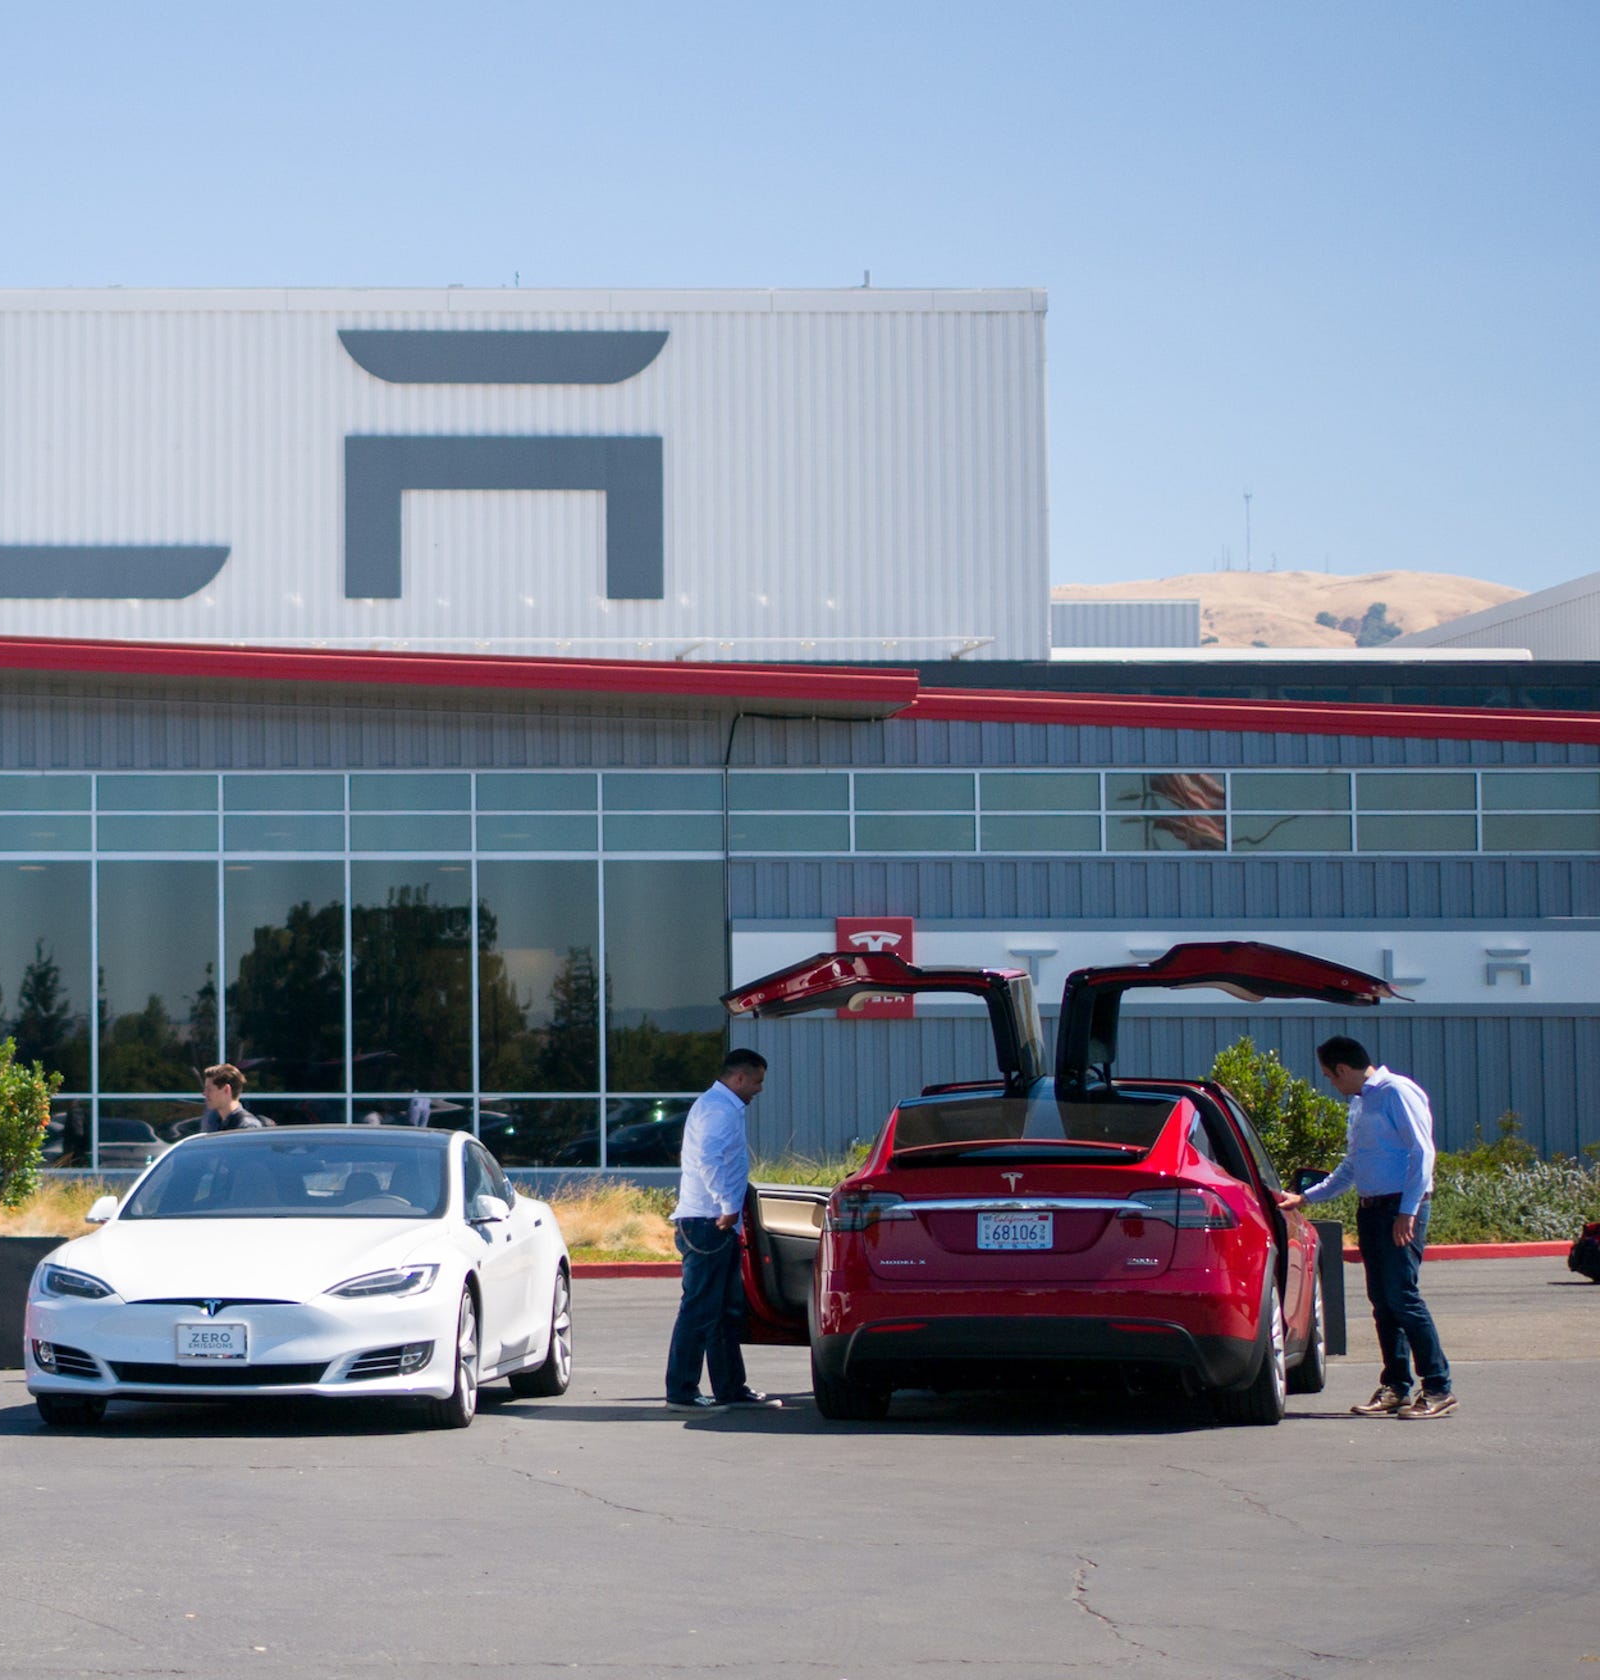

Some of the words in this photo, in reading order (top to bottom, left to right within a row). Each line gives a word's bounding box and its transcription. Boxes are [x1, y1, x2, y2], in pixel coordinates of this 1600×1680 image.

[1009, 948, 1531, 986] TLA
[992, 1224, 1038, 1240] 68106
[191, 1332, 231, 1343] ZERO
